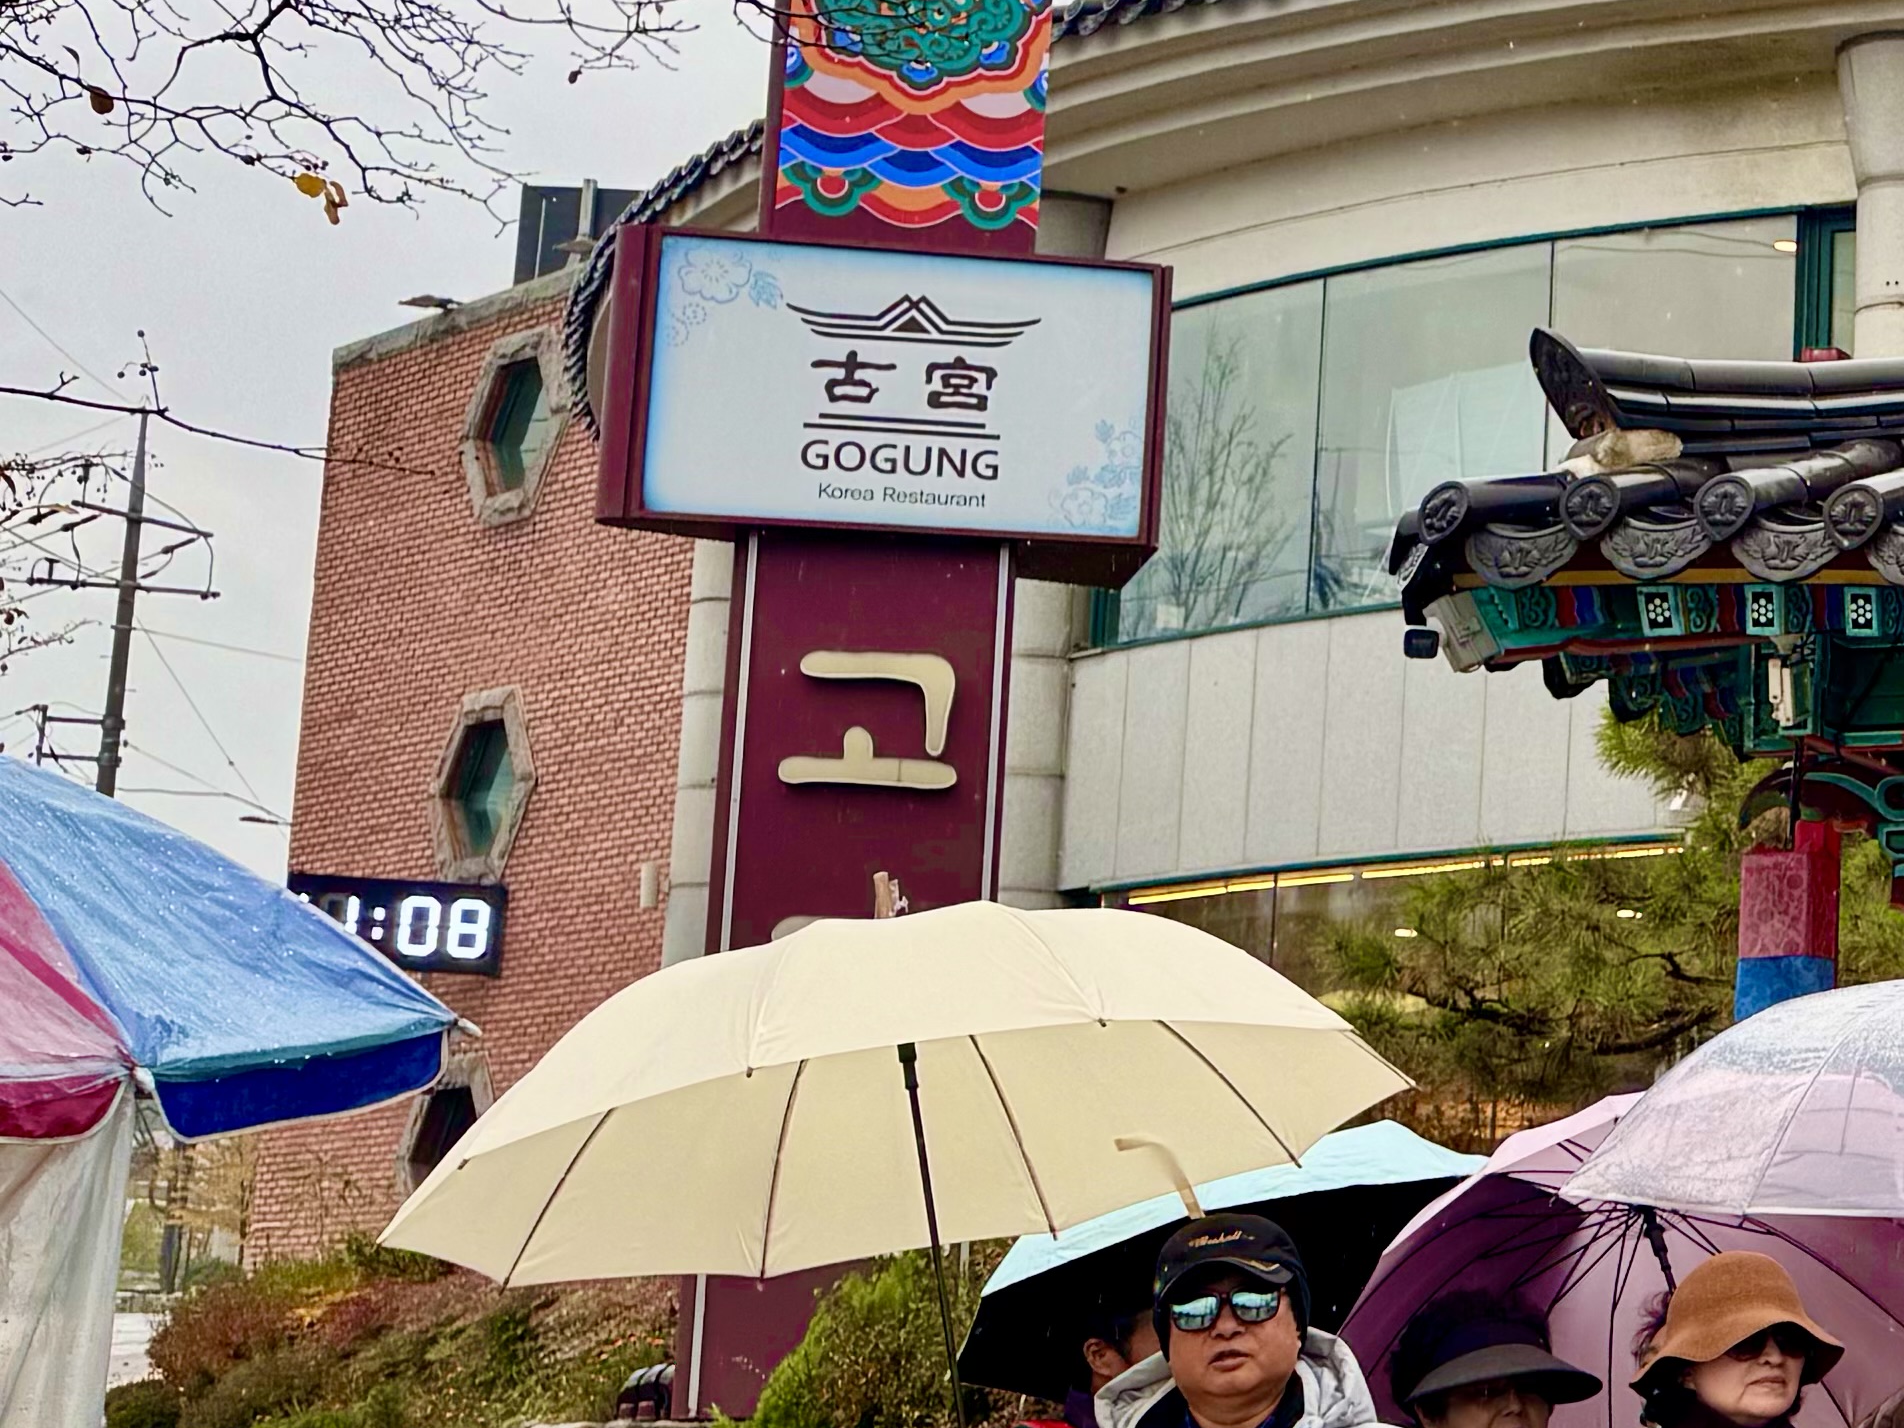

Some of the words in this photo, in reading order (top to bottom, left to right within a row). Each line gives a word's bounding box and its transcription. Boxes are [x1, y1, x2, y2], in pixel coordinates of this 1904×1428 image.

[800, 439, 999, 481] GOGUNG
[818, 482, 875, 502] Korea
[882, 486, 986, 508] Restaurant
